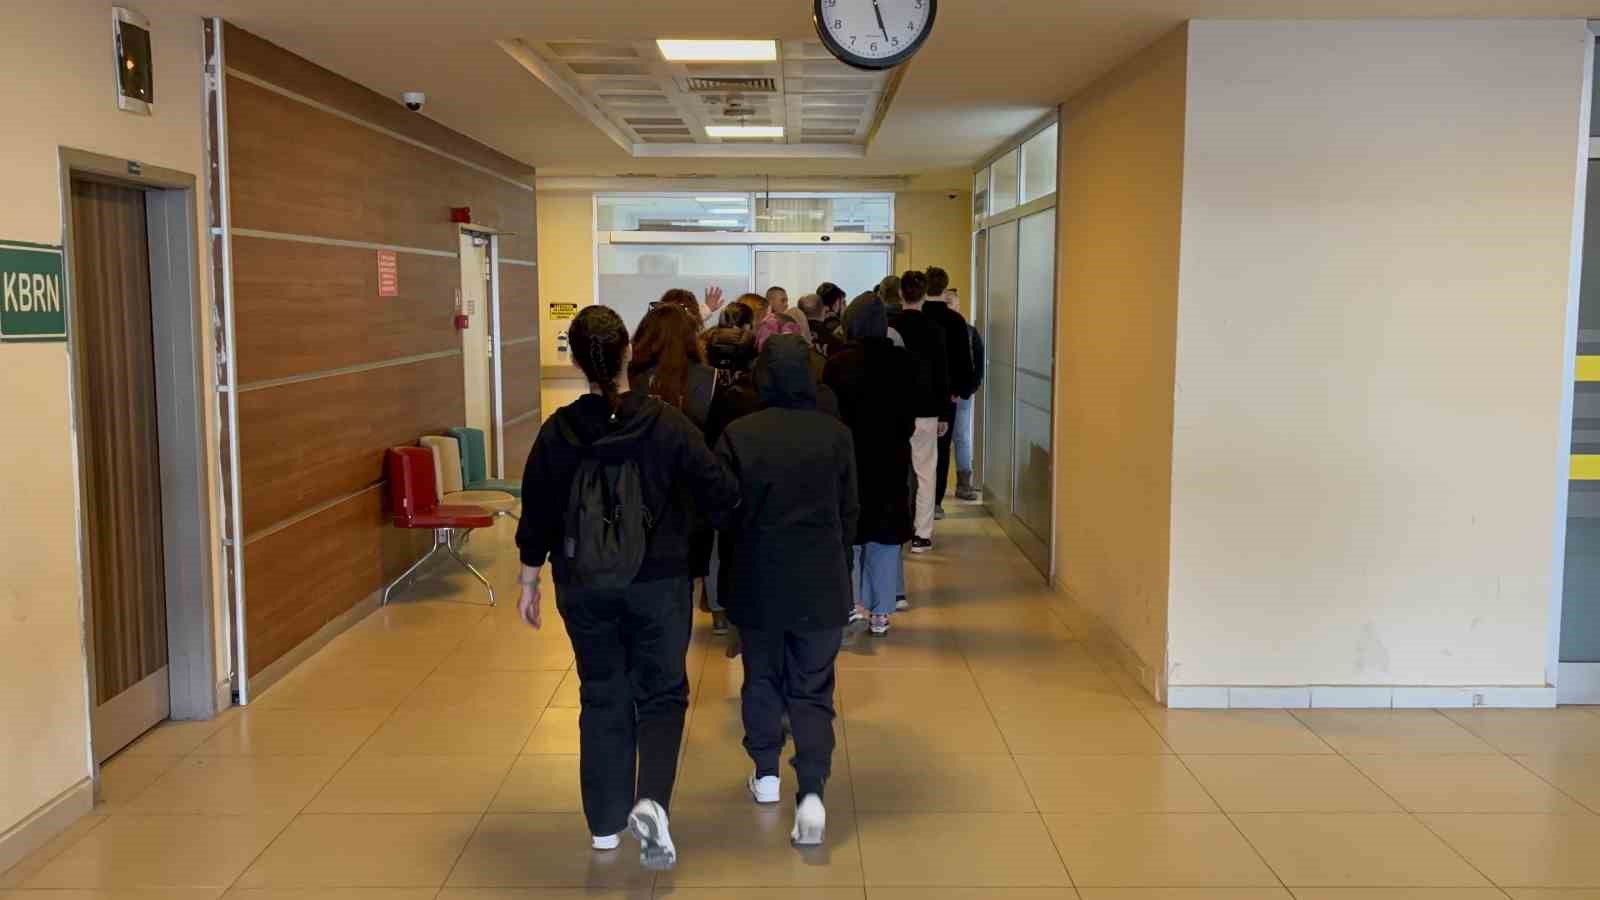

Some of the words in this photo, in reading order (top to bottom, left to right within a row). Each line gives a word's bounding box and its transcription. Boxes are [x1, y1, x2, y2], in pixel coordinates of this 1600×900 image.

[914, 0, 922, 8] 3
[834, 19, 842, 30] 8
[907, 20, 914, 31] 4
[849, 36, 857, 45] 7
[891, 37, 899, 47] 5
[870, 41, 878, 52] 6
[3, 271, 60, 313] KBRN
